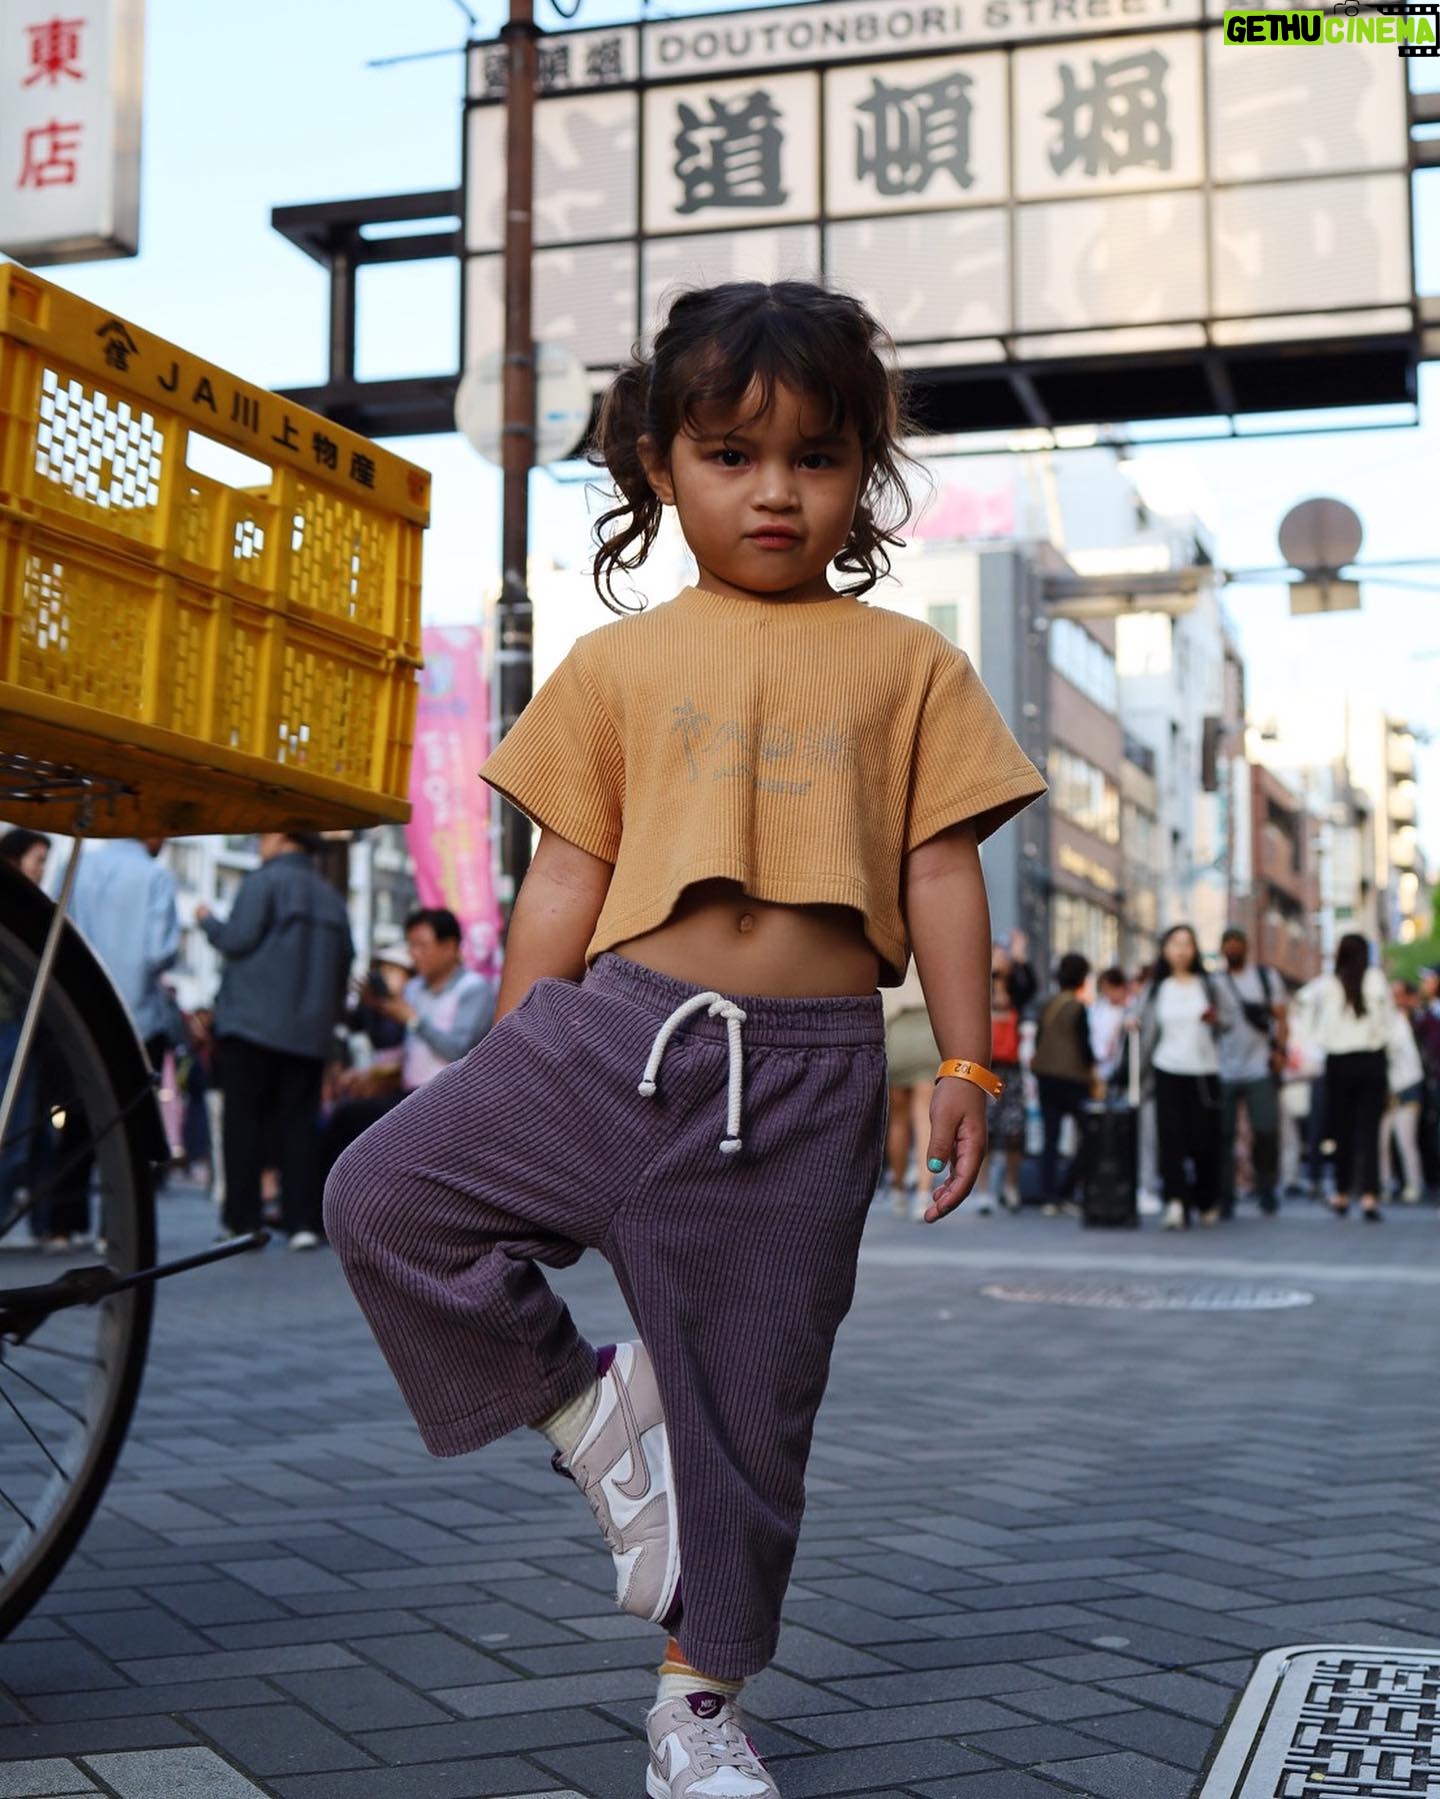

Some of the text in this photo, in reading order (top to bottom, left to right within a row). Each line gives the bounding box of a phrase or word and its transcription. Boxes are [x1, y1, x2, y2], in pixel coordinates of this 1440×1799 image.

[658, 6, 962, 63] DOUTONBORI
[672, 48, 1174, 214] 道頓堀
